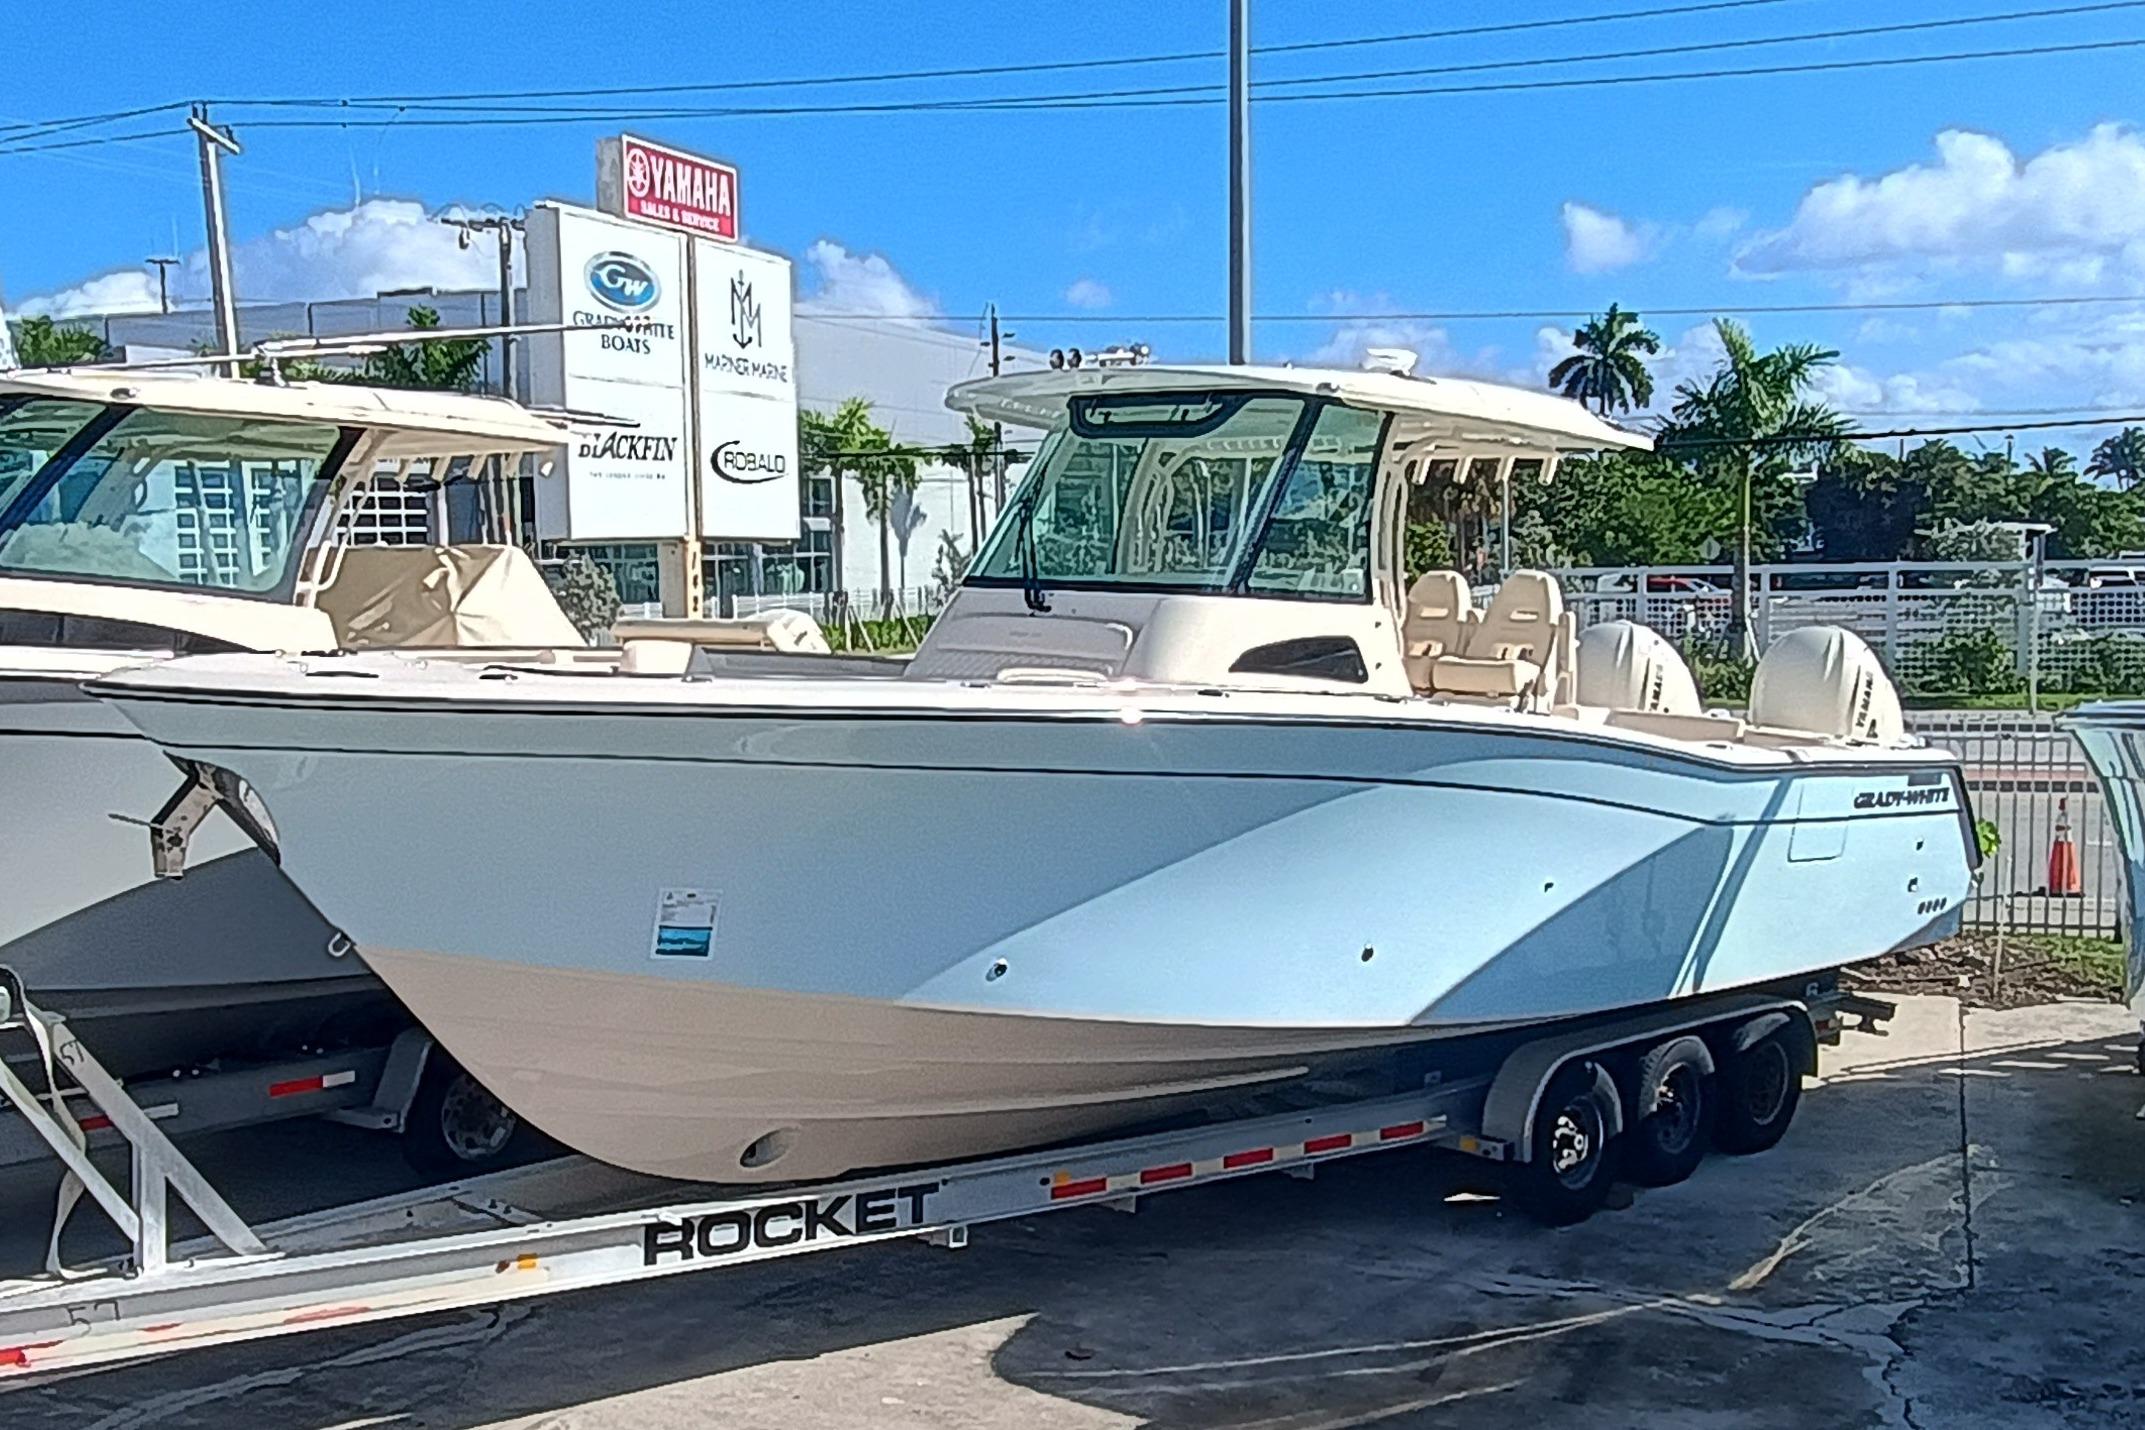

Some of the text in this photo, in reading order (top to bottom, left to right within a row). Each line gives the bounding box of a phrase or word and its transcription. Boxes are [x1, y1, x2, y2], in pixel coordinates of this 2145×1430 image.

[650, 154, 731, 216] YAMAHA
[641, 199, 671, 219] SALES
[681, 210, 720, 232] SERVICE
[601, 333, 651, 354] BOATS
[723, 451, 786, 473] ROBALO
[1853, 787, 1950, 809] GRADY-WHITE
[643, 1181, 940, 1267] ROCKET
[66, 1299, 121, 1337] 57
